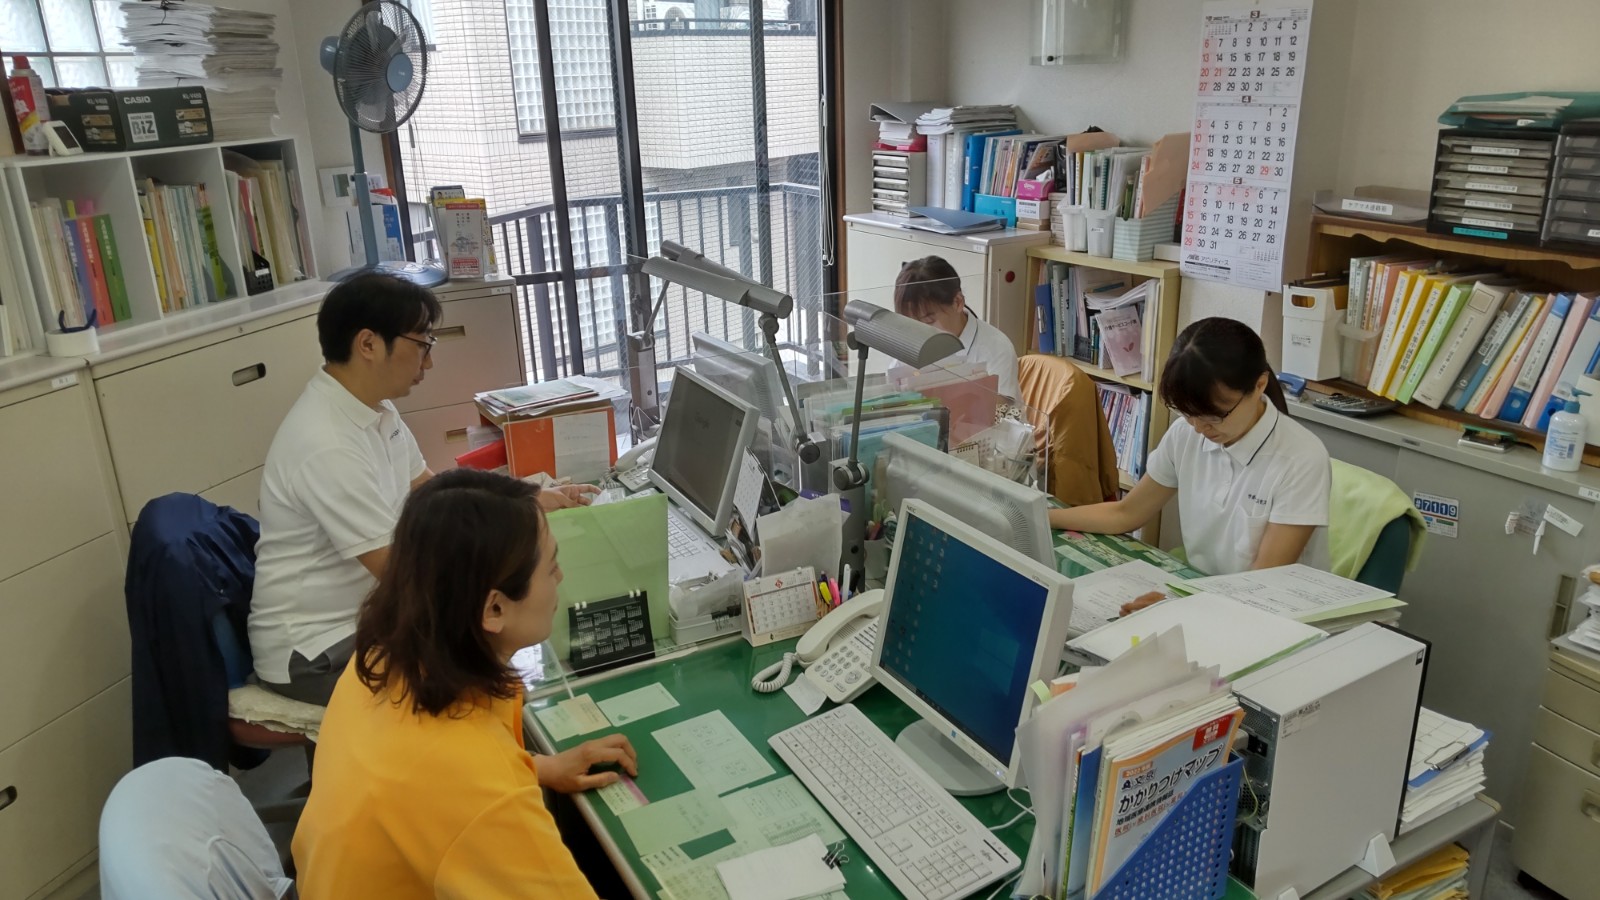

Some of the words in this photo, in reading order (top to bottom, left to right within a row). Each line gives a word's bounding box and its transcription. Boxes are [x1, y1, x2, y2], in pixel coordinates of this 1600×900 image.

[1234, 24, 1238, 32] 1
[1248, 23, 1252, 31] 2
[1263, 22, 1267, 31] 3
[1278, 21, 1282, 30] 4
[1292, 21, 1297, 29] 5
[1205, 40, 1209, 48] 6
[1219, 39, 1223, 47] 7
[1233, 38, 1237, 47] 8
[1246, 38, 1251, 46] 9
[1260, 37, 1267, 46] 10
[1275, 37, 1281, 46] 11
[1290, 36, 1297, 45] 12
[1203, 53, 1209, 62] 13
[1216, 53, 1222, 62] 14
[1230, 53, 1237, 62] 15
[1244, 53, 1251, 61] 16
[1259, 52, 1265, 61] 17
[1273, 52, 1280, 61] 18
[1288, 52, 1295, 61] 19
[1228, 68, 1236, 76] 22
[1256, 68, 1264, 76] 24
[1271, 68, 1280, 76] 25
[1286, 67, 1295, 76] 26
[1199, 82, 1207, 91] 27
[1213, 82, 1221, 91] 28
[1227, 82, 1235, 91] 29
[1241, 82, 1249, 91] 30
[1255, 82, 1262, 91] 31
[123, 96, 152, 105] CASIO
[1269, 108, 1272, 116] 1
[1282, 108, 1287, 117] 2
[1238, 121, 1243, 130] 6
[1252, 122, 1257, 130] 7
[1266, 122, 1271, 131] 8
[1281, 123, 1286, 132] 9
[1208, 135, 1214, 143] 11
[1236, 136, 1242, 144] 13
[1250, 136, 1256, 145] 14
[1264, 137, 1270, 146] 15
[1278, 138, 1285, 147] 16
[1207, 149, 1213, 157] 18
[1221, 149, 1227, 158] 19
[1234, 150, 1242, 159] 20
[1248, 151, 1255, 159] 21
[1262, 152, 1270, 160] 22
[1276, 153, 1284, 161] 23
[1219, 163, 1226, 172] 26
[1232, 164, 1240, 173] 27
[1246, 165, 1254, 174] 28
[1260, 166, 1269, 175] 29
[1274, 167, 1282, 176] 30
[1245, 189, 1249, 197] 5
[1259, 191, 1263, 199] 6
[1273, 192, 1278, 200] 7
[1257, 205, 1263, 213] 13
[1270, 206, 1277, 215] 14
[1213, 214, 1220, 222] 17
[1227, 216, 1233, 224] 18
[1241, 217, 1247, 225] 19
[1254, 219, 1262, 227] 20
[1268, 220, 1275, 229] 21
[1225, 229, 1232, 238] 25
[1238, 231, 1246, 239] 26
[1252, 233, 1260, 241] 27
[1266, 234, 1275, 244] 28
[1197, 239, 1205, 247] 30
[1415, 498, 1457, 517] #7119
[1118, 743, 1224, 815] かかりつけマップ
